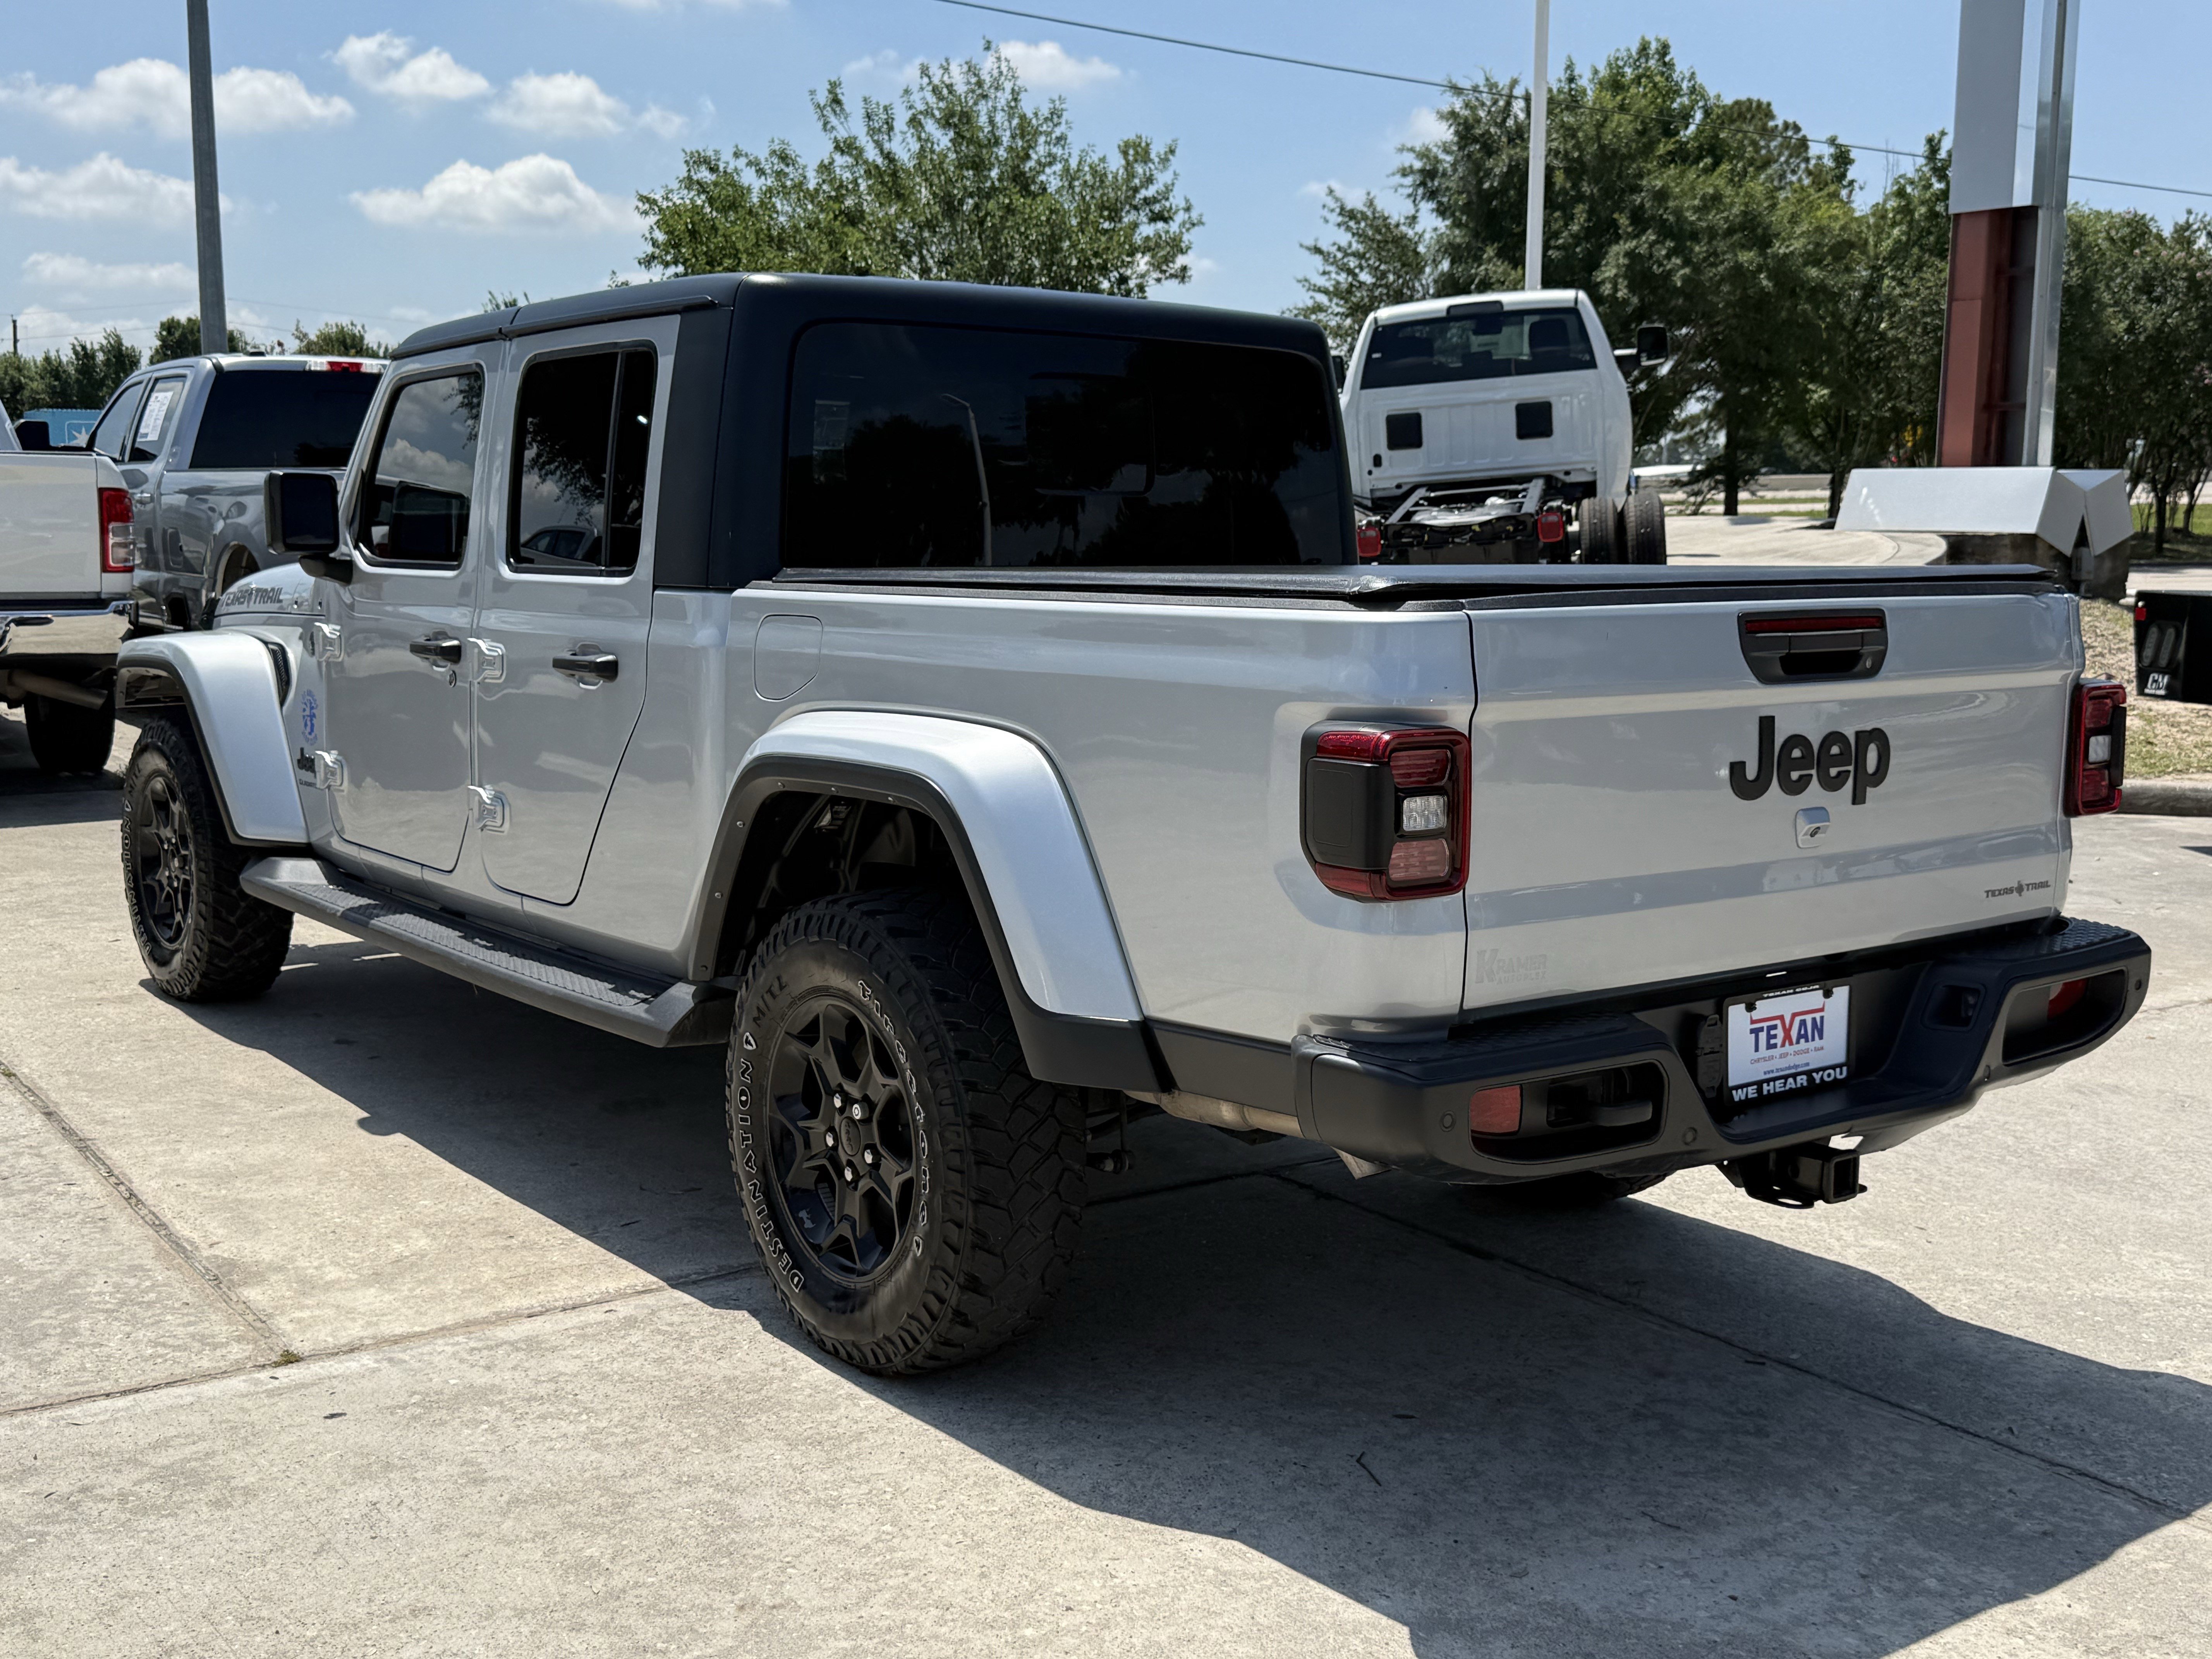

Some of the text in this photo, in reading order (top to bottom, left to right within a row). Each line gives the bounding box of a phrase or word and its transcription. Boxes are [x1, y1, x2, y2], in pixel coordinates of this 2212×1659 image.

[254, 587, 283, 604] TRAIL
[1729, 716, 1890, 805] Jeep
[120, 816, 151, 956] DESTINATION
[1984, 880, 2051, 898] TEXAS TRAIL
[1496, 971, 1546, 985] AUTOPLEX
[1750, 1002, 1824, 1053] TEXAN
[1750, 1055, 1774, 1064] CHRYSLER
[1793, 1048, 1810, 1056] DODGE
[1732, 1066, 1847, 1101] WE HEAR YOU
[738, 1058, 804, 1293] DESTINATION
